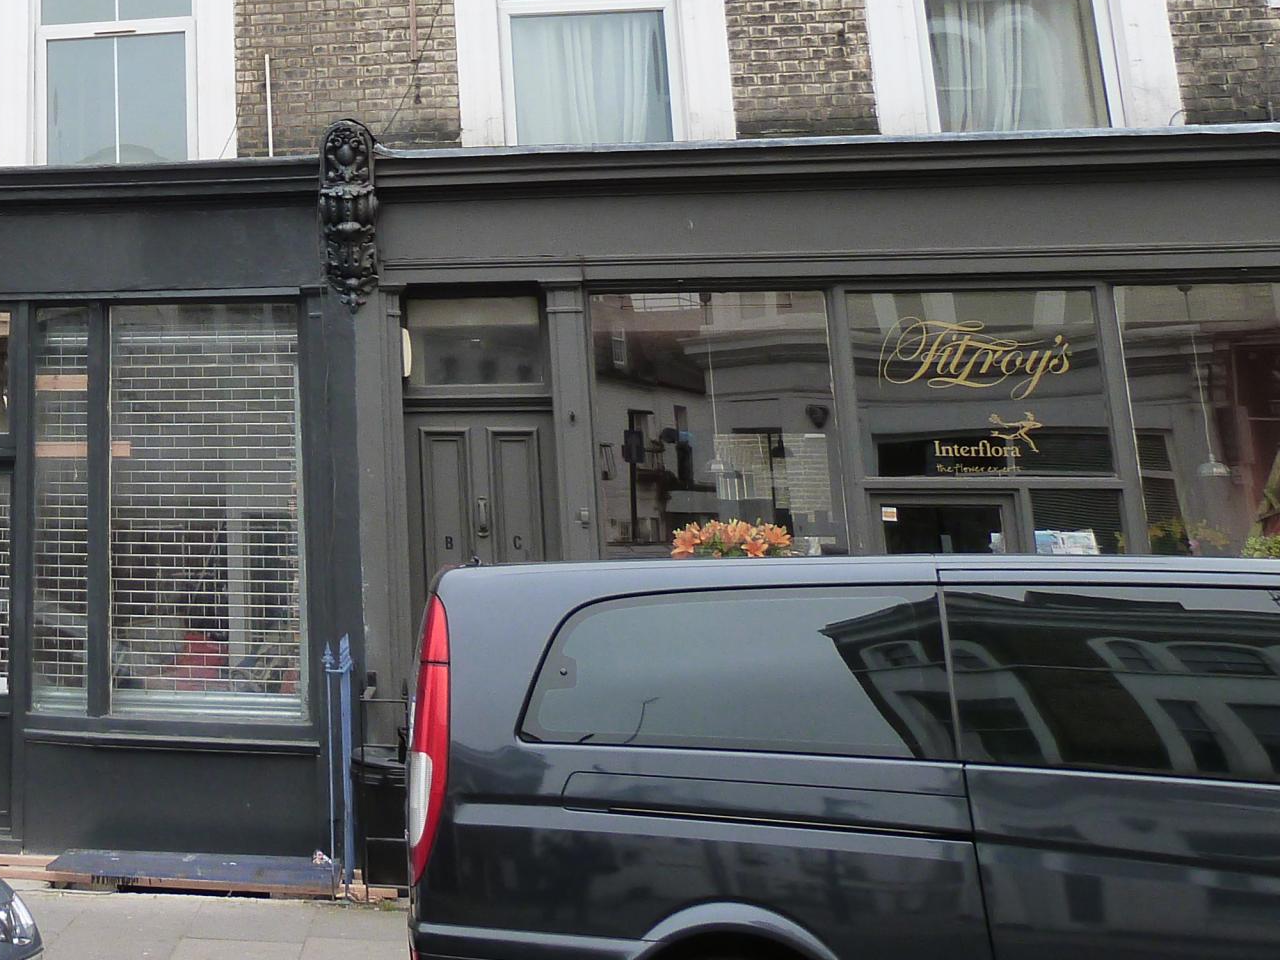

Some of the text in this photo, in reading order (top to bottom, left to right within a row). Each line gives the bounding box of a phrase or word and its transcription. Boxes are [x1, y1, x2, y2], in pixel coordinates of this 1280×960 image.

[878, 316, 1072, 400] Fitzroy's
[933, 440, 1022, 457] Interflora
[936, 464, 953, 473] the
[953, 464, 985, 476] flower
[445, 536, 454, 550] B
[513, 535, 522, 550] C
